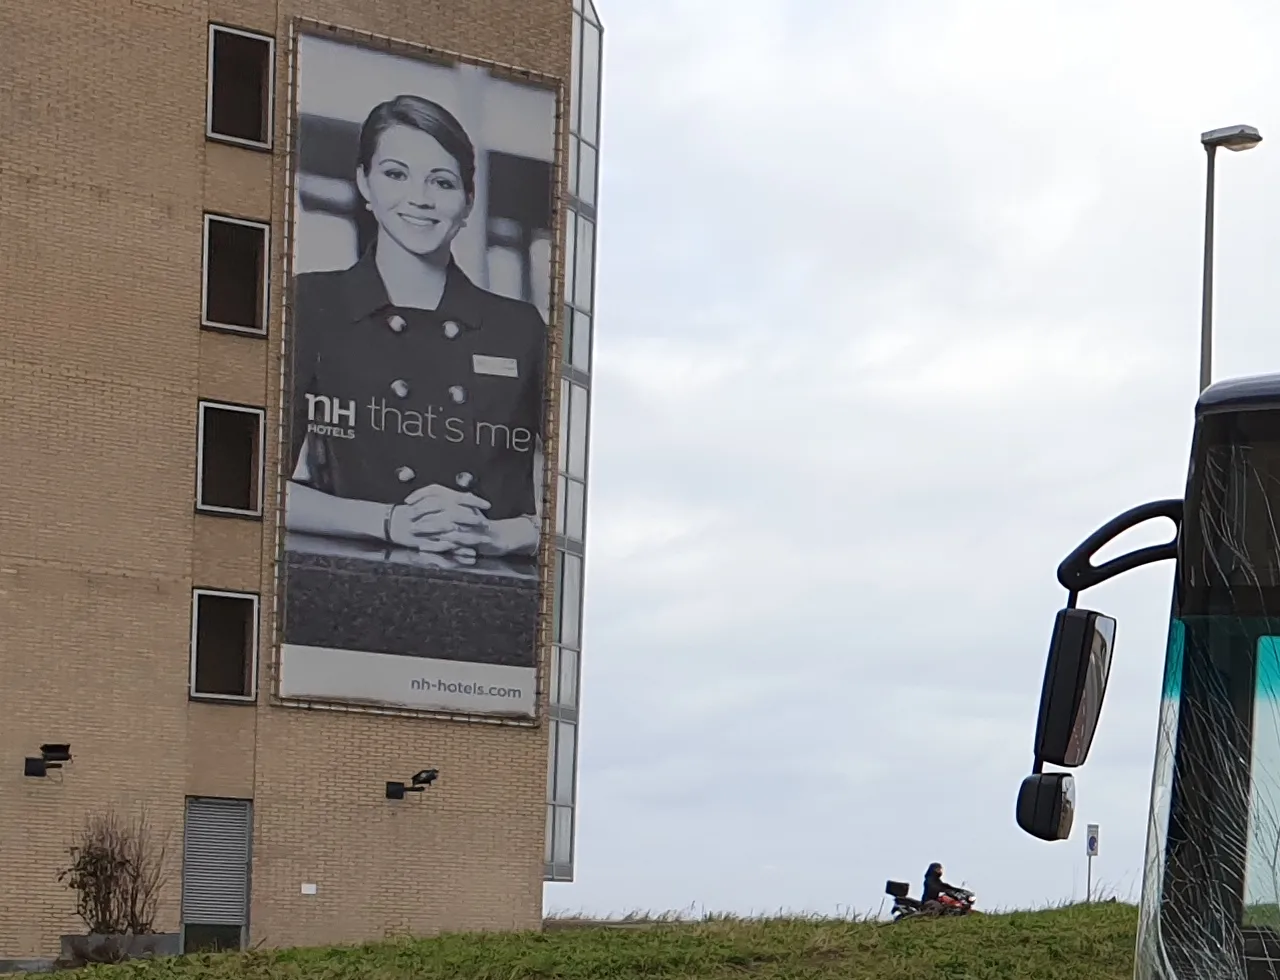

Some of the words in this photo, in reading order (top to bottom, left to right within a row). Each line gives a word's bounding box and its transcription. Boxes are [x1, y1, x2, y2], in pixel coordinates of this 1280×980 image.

[307, 423, 356, 440] HOTELS
[367, 396, 465, 443] that's
[475, 421, 531, 452] me
[411, 678, 522, 699] nh-hotels.com
